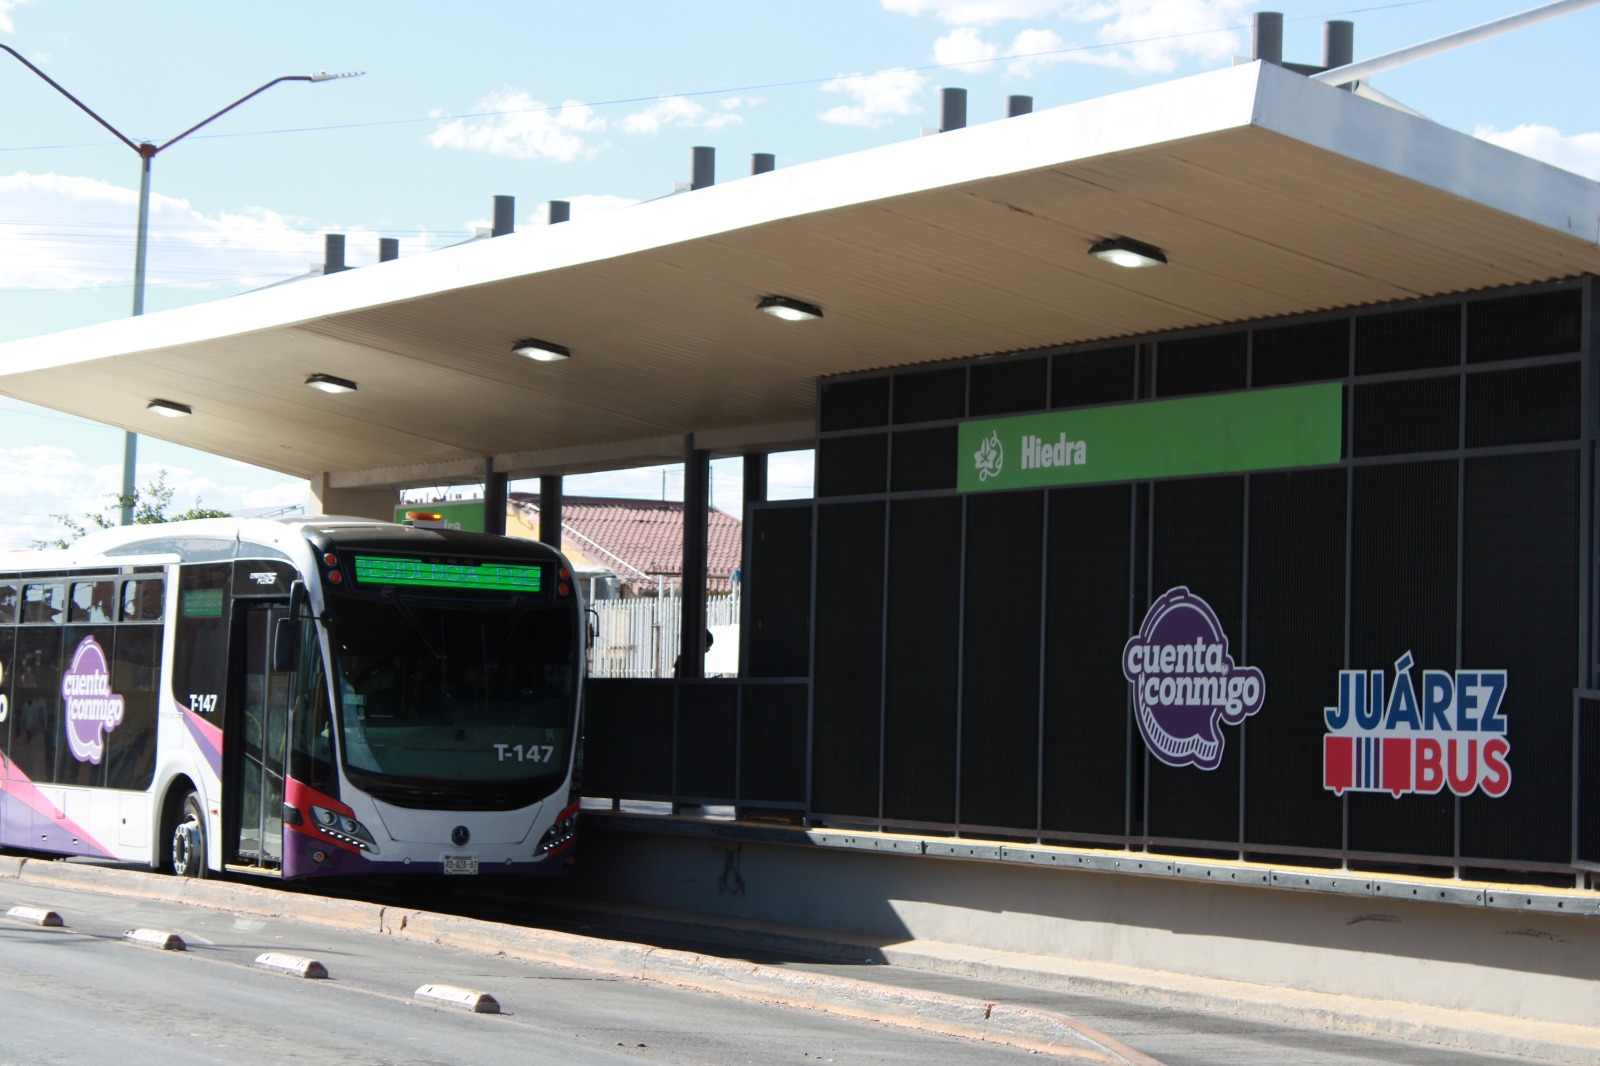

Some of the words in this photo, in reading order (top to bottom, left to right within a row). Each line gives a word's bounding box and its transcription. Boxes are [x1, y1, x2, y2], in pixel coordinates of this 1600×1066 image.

[1021, 432, 1087, 469] Hiedra
[1127, 636, 1223, 674] cuenta
[64, 669, 108, 696] cuenta
[1144, 676, 1260, 716] conmigo
[1325, 651, 1506, 732] JUÁREZ
[70, 698, 123, 727] conmigo
[189, 694, 218, 712] T-147
[493, 744, 554, 763] T-147
[1415, 738, 1510, 795] BUS
